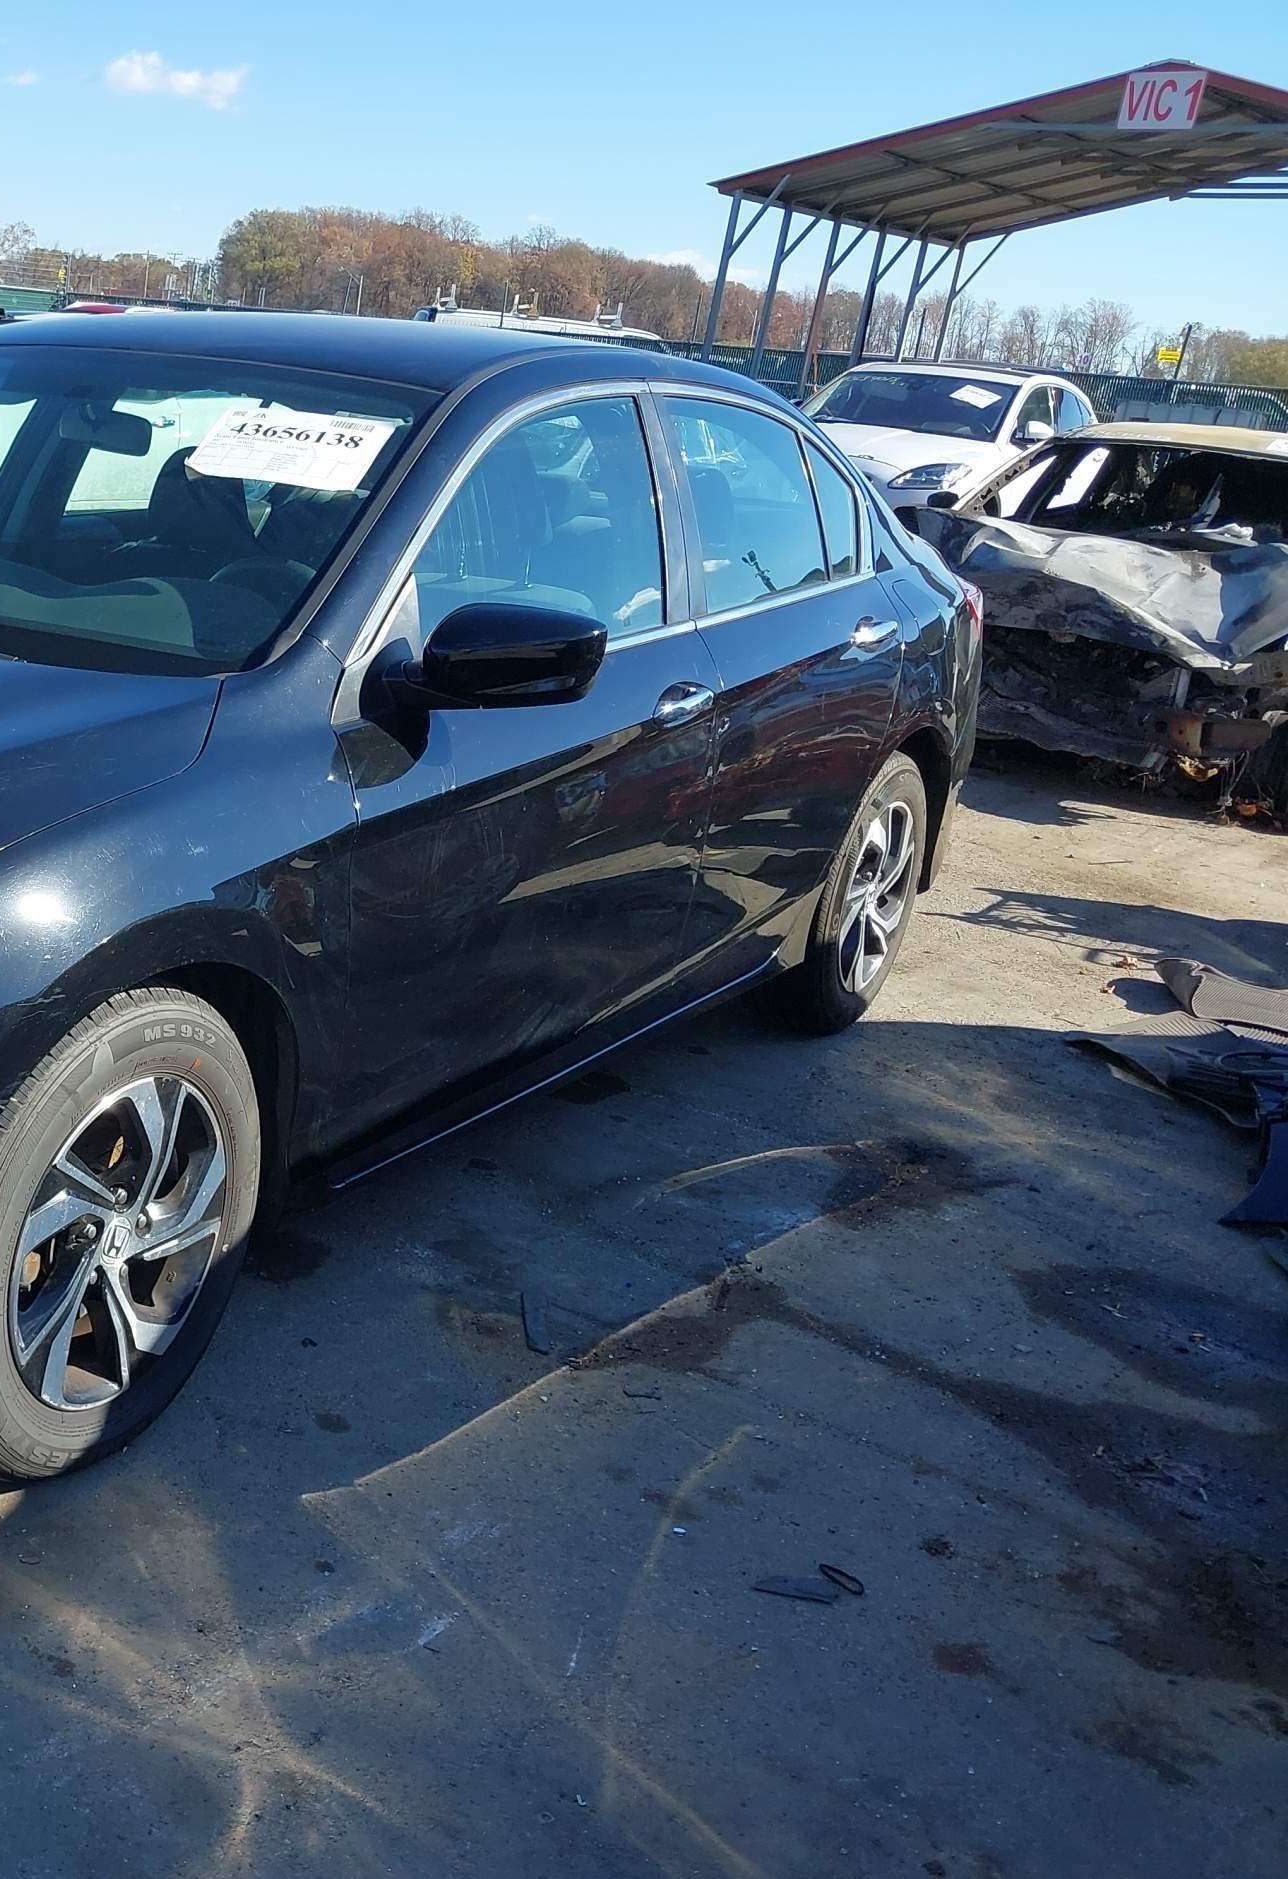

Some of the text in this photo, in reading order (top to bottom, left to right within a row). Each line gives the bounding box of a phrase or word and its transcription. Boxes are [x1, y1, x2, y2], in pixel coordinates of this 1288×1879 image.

[1127, 79, 1204, 122] VIC 1
[229, 421, 364, 449] 43656138
[143, 1023, 218, 1049] MS 932
